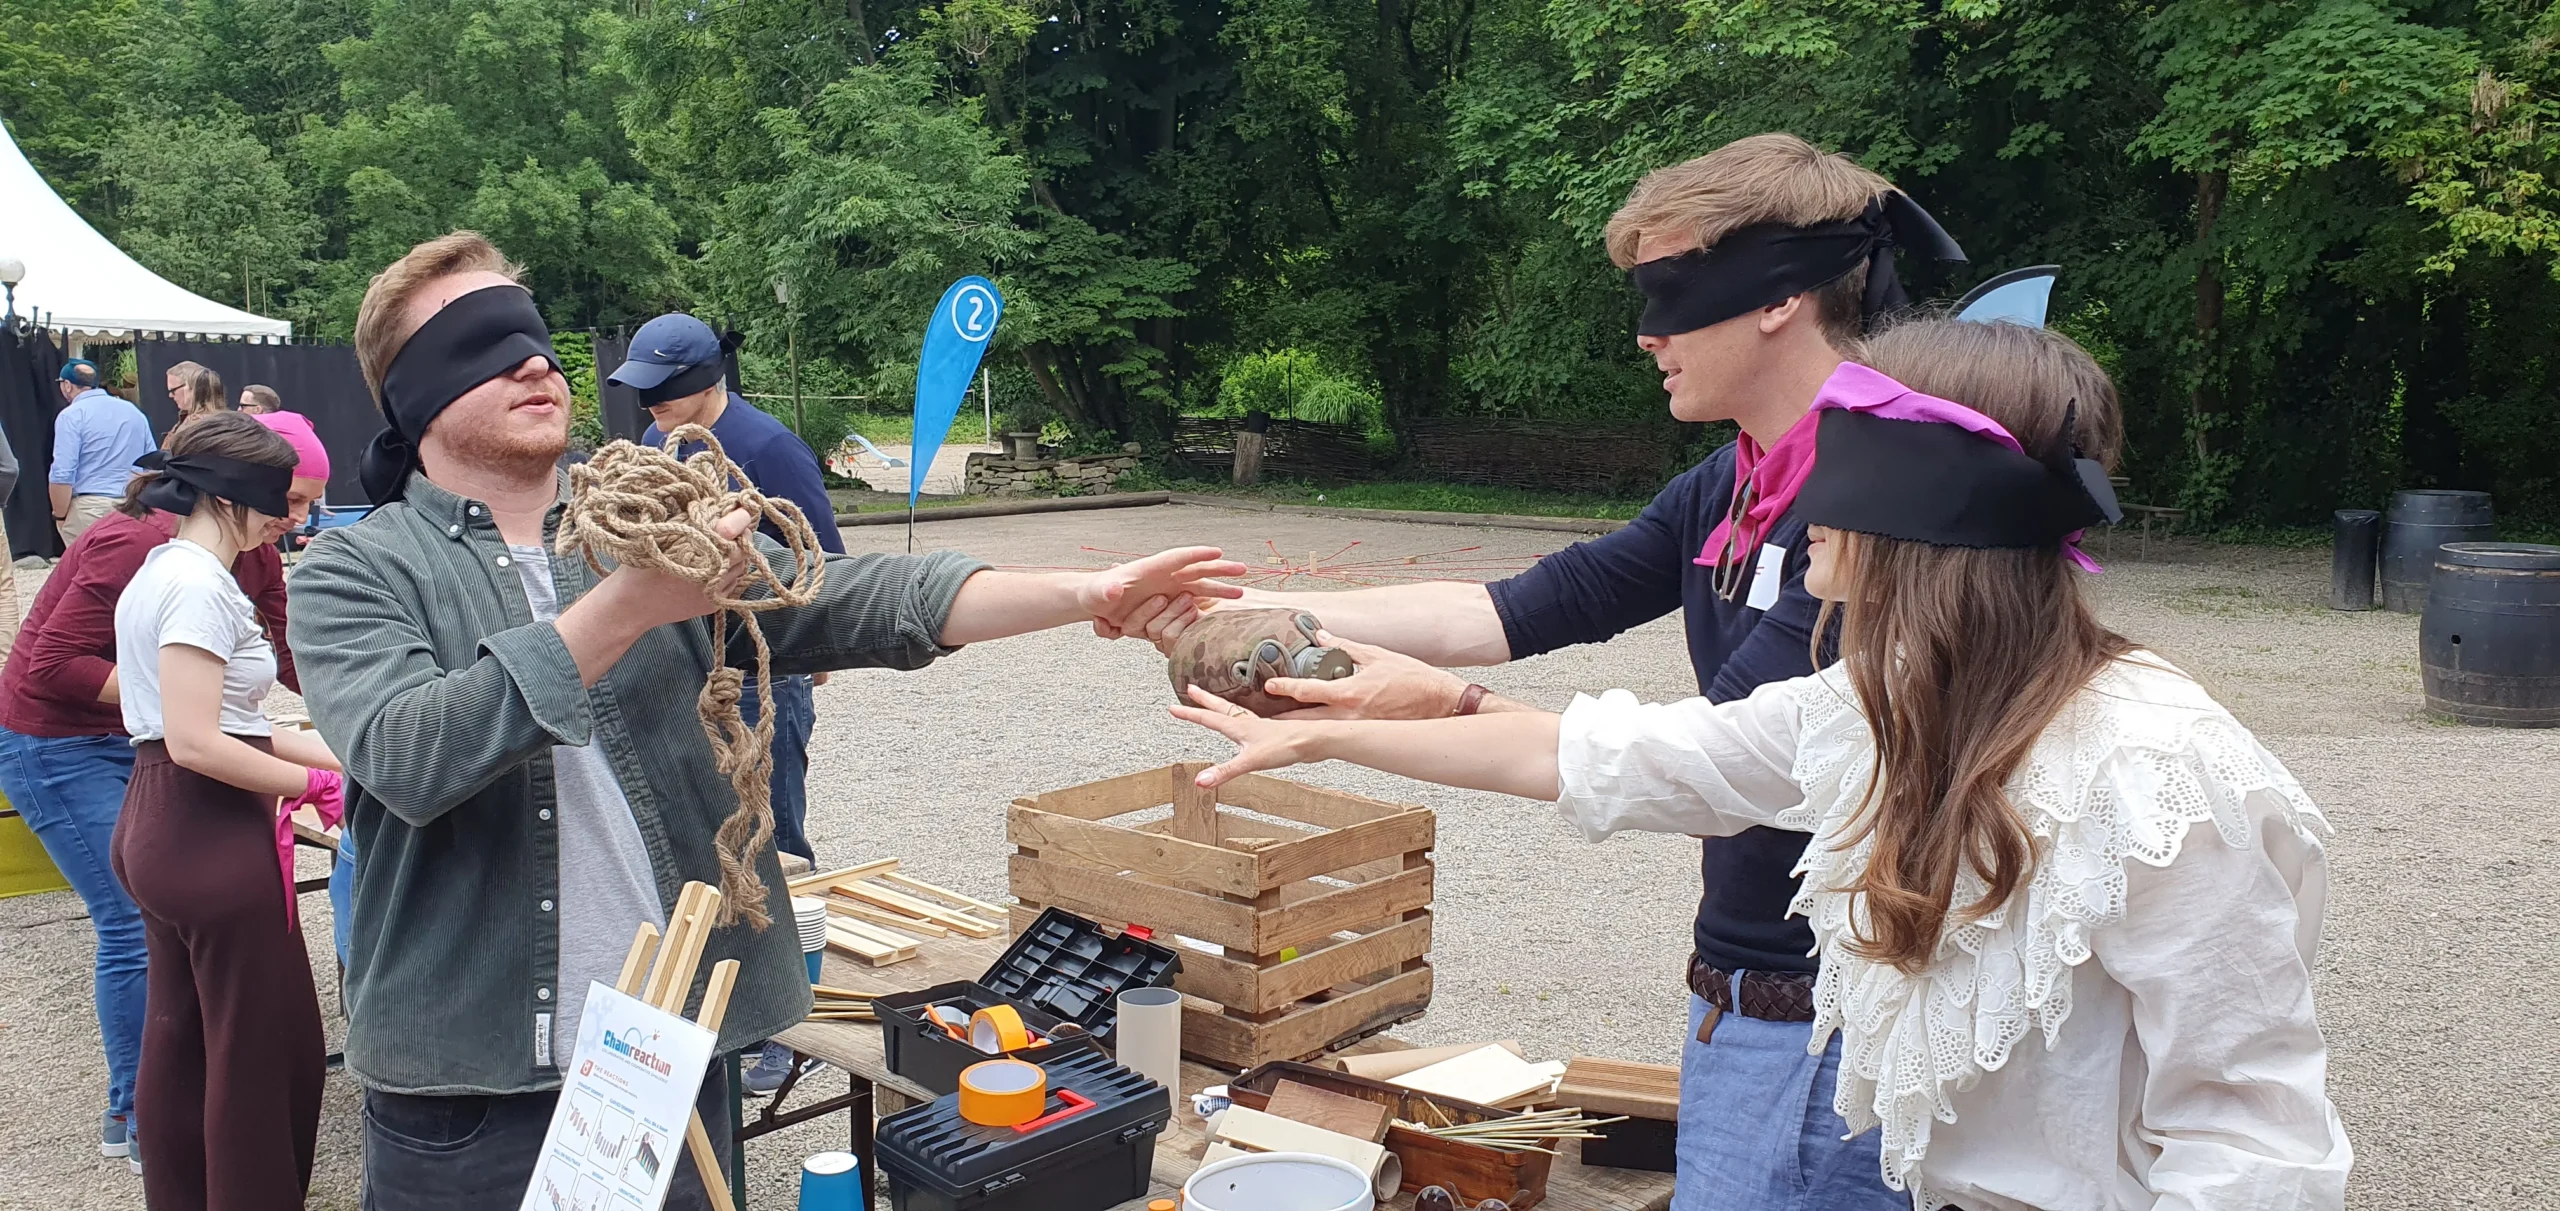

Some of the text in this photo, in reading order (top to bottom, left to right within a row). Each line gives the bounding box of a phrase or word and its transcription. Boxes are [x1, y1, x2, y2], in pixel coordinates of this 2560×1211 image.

[967, 296, 984, 331] 2
[603, 1029, 672, 1077] Chainreaction
[594, 1064, 603, 1073] THE
[603, 1069, 629, 1087] REACTIONS
